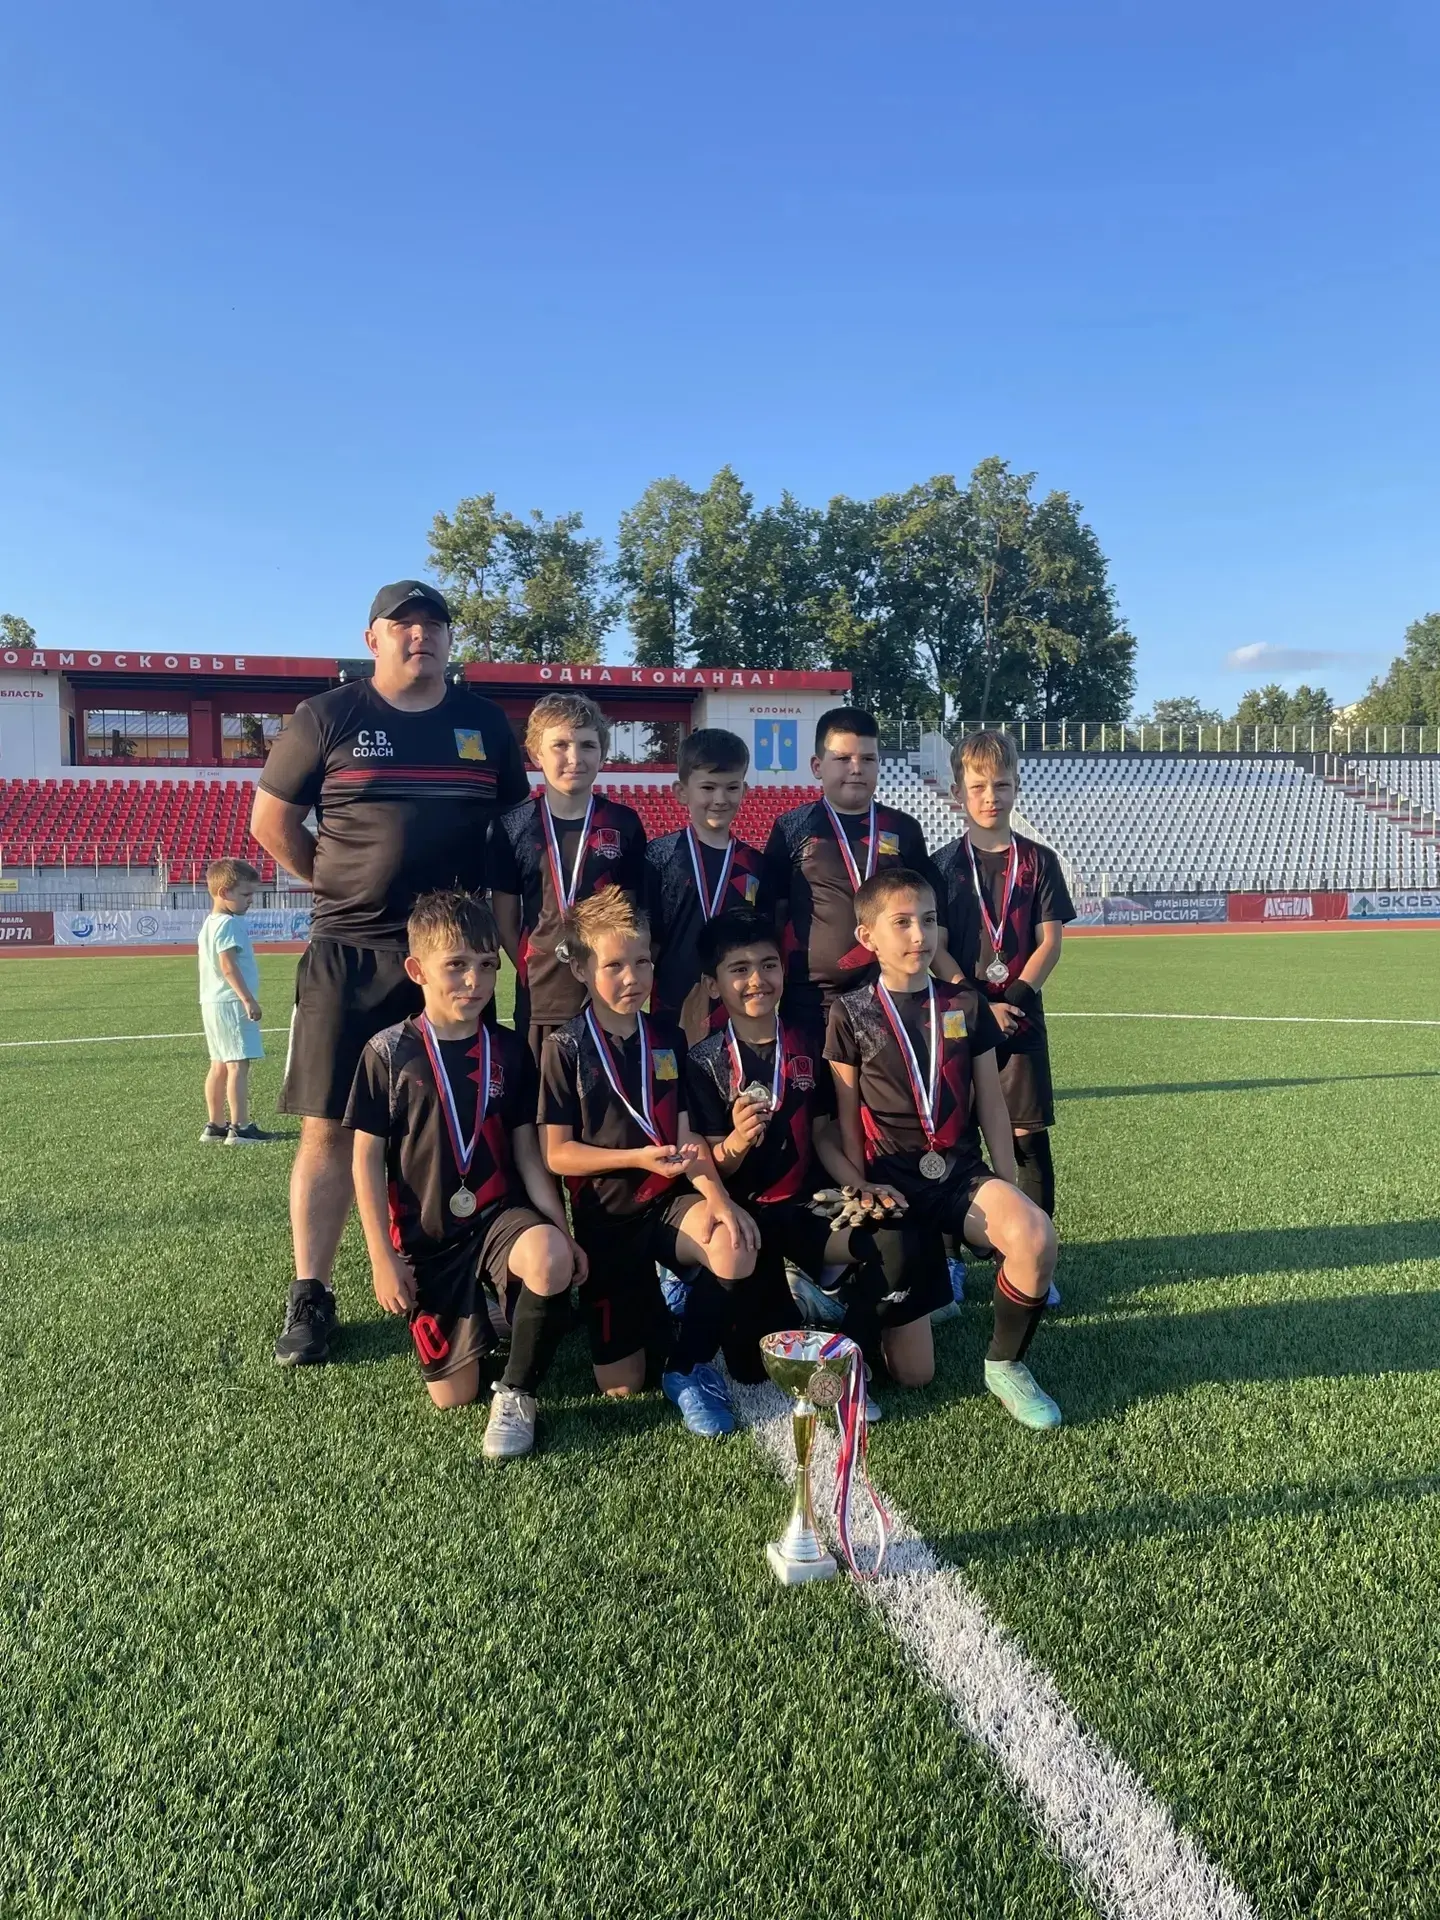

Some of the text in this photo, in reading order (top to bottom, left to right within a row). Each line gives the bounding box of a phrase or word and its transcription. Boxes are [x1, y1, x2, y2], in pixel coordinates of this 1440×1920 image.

[3, 651, 246, 671] ОДМОСКОВЬЕ
[539, 667, 775, 685] ОДНА КОМАНДА!
[0, 690, 44, 698] БЛАСТЬ
[749, 706, 802, 714] КОЛОМНА
[352, 747, 394, 757] COACH
[1153, 898, 1226, 908] #МЫВМЕСТЕ
[1107, 909, 1200, 921] #МЫРОССИЯ
[409, 1314, 450, 1365] 10
